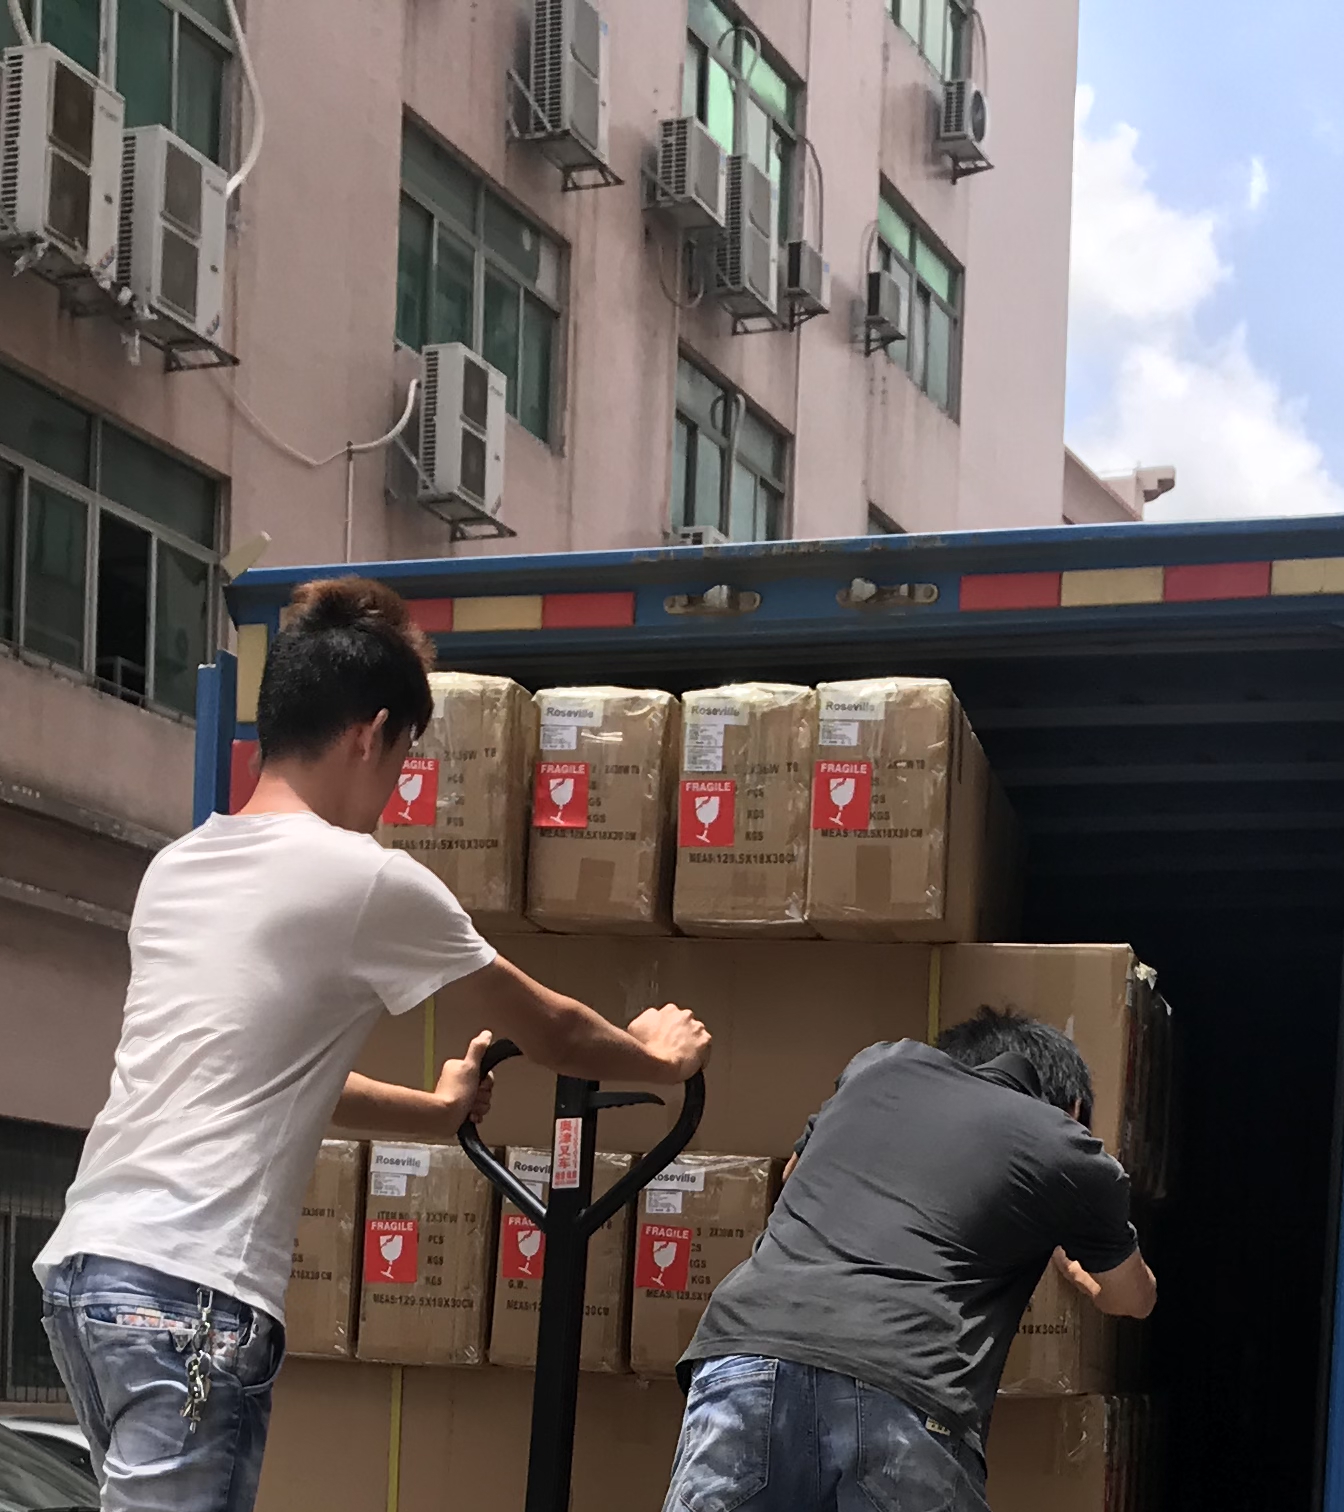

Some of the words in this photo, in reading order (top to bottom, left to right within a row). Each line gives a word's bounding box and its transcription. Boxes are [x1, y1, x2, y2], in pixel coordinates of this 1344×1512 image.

[691, 705, 740, 717] Roseville
[825, 701, 875, 712] Roseville
[546, 707, 594, 719] Roseville
[402, 759, 435, 770] AGILE
[540, 764, 585, 774] FRAGILE
[820, 763, 867, 774] FRAGILE
[685, 782, 731, 792] FRAGILE
[375, 1155, 421, 1169] Roseville
[513, 1160, 552, 1175] Rosevil
[371, 1221, 413, 1232] FRAGILE
[645, 1225, 690, 1239] FRAGILE
[427, 1235, 444, 1245] PCS
[426, 1255, 444, 1266] KGS
[691, 1275, 712, 1285] KGS
